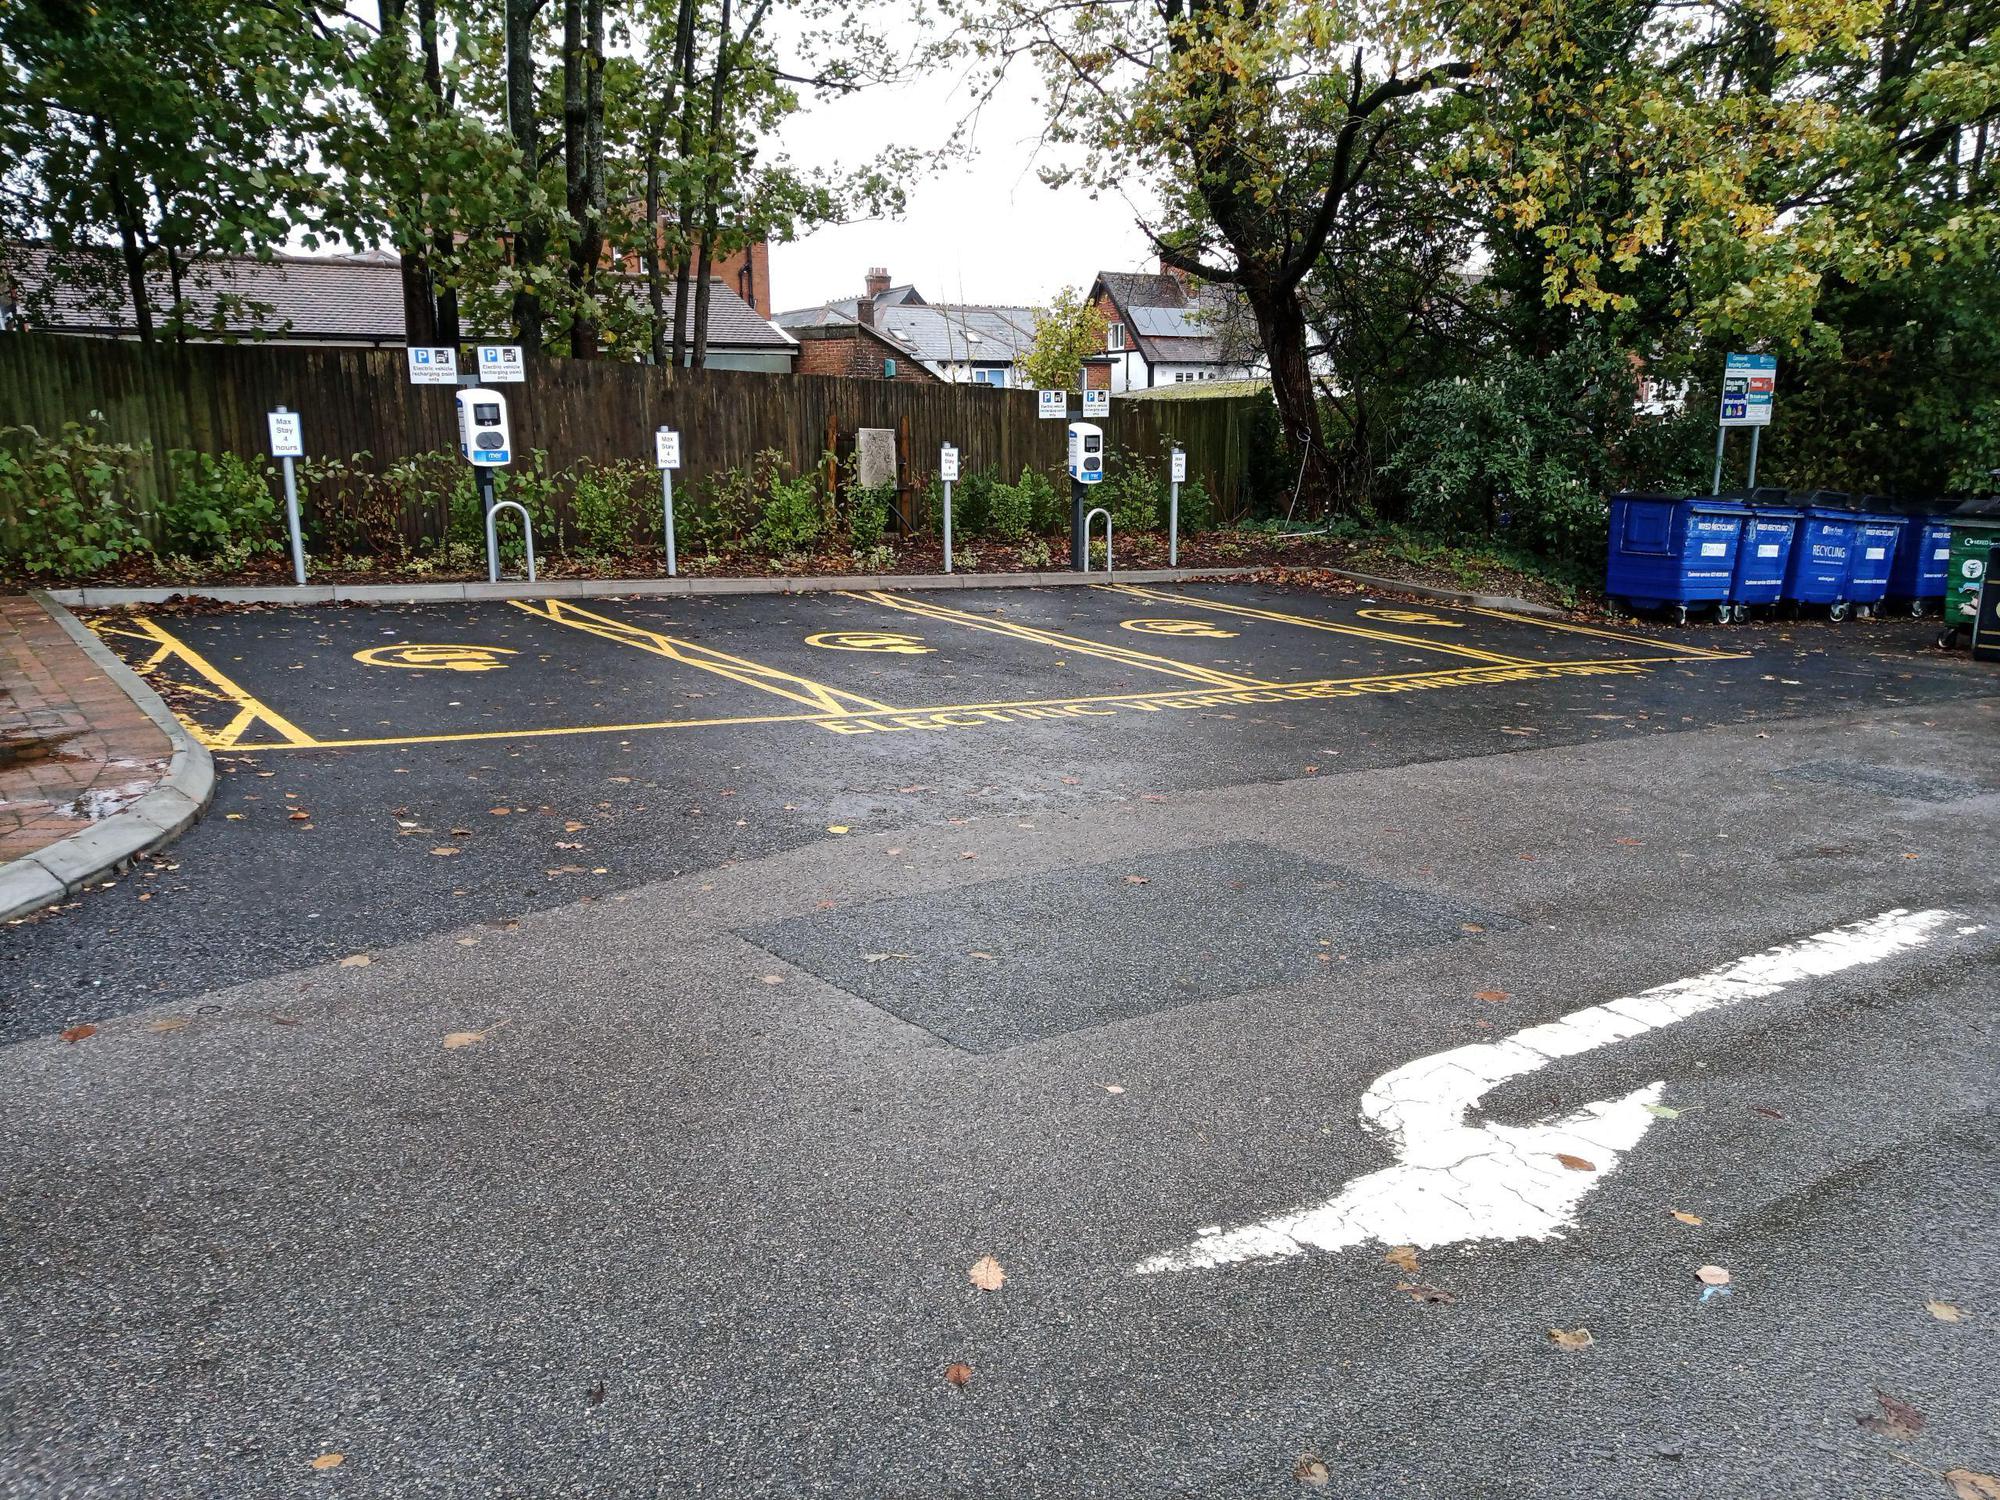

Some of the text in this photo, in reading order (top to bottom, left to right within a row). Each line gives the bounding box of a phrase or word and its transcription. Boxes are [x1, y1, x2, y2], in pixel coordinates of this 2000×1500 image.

[1712, 523, 1734, 531] RECYCLING
[1812, 545, 1846, 558] RECYCLING
[816, 704, 1117, 735] ELECTRIC
[1107, 687, 1361, 711] VEHICLES
[1349, 669, 1562, 693] CHARGING
